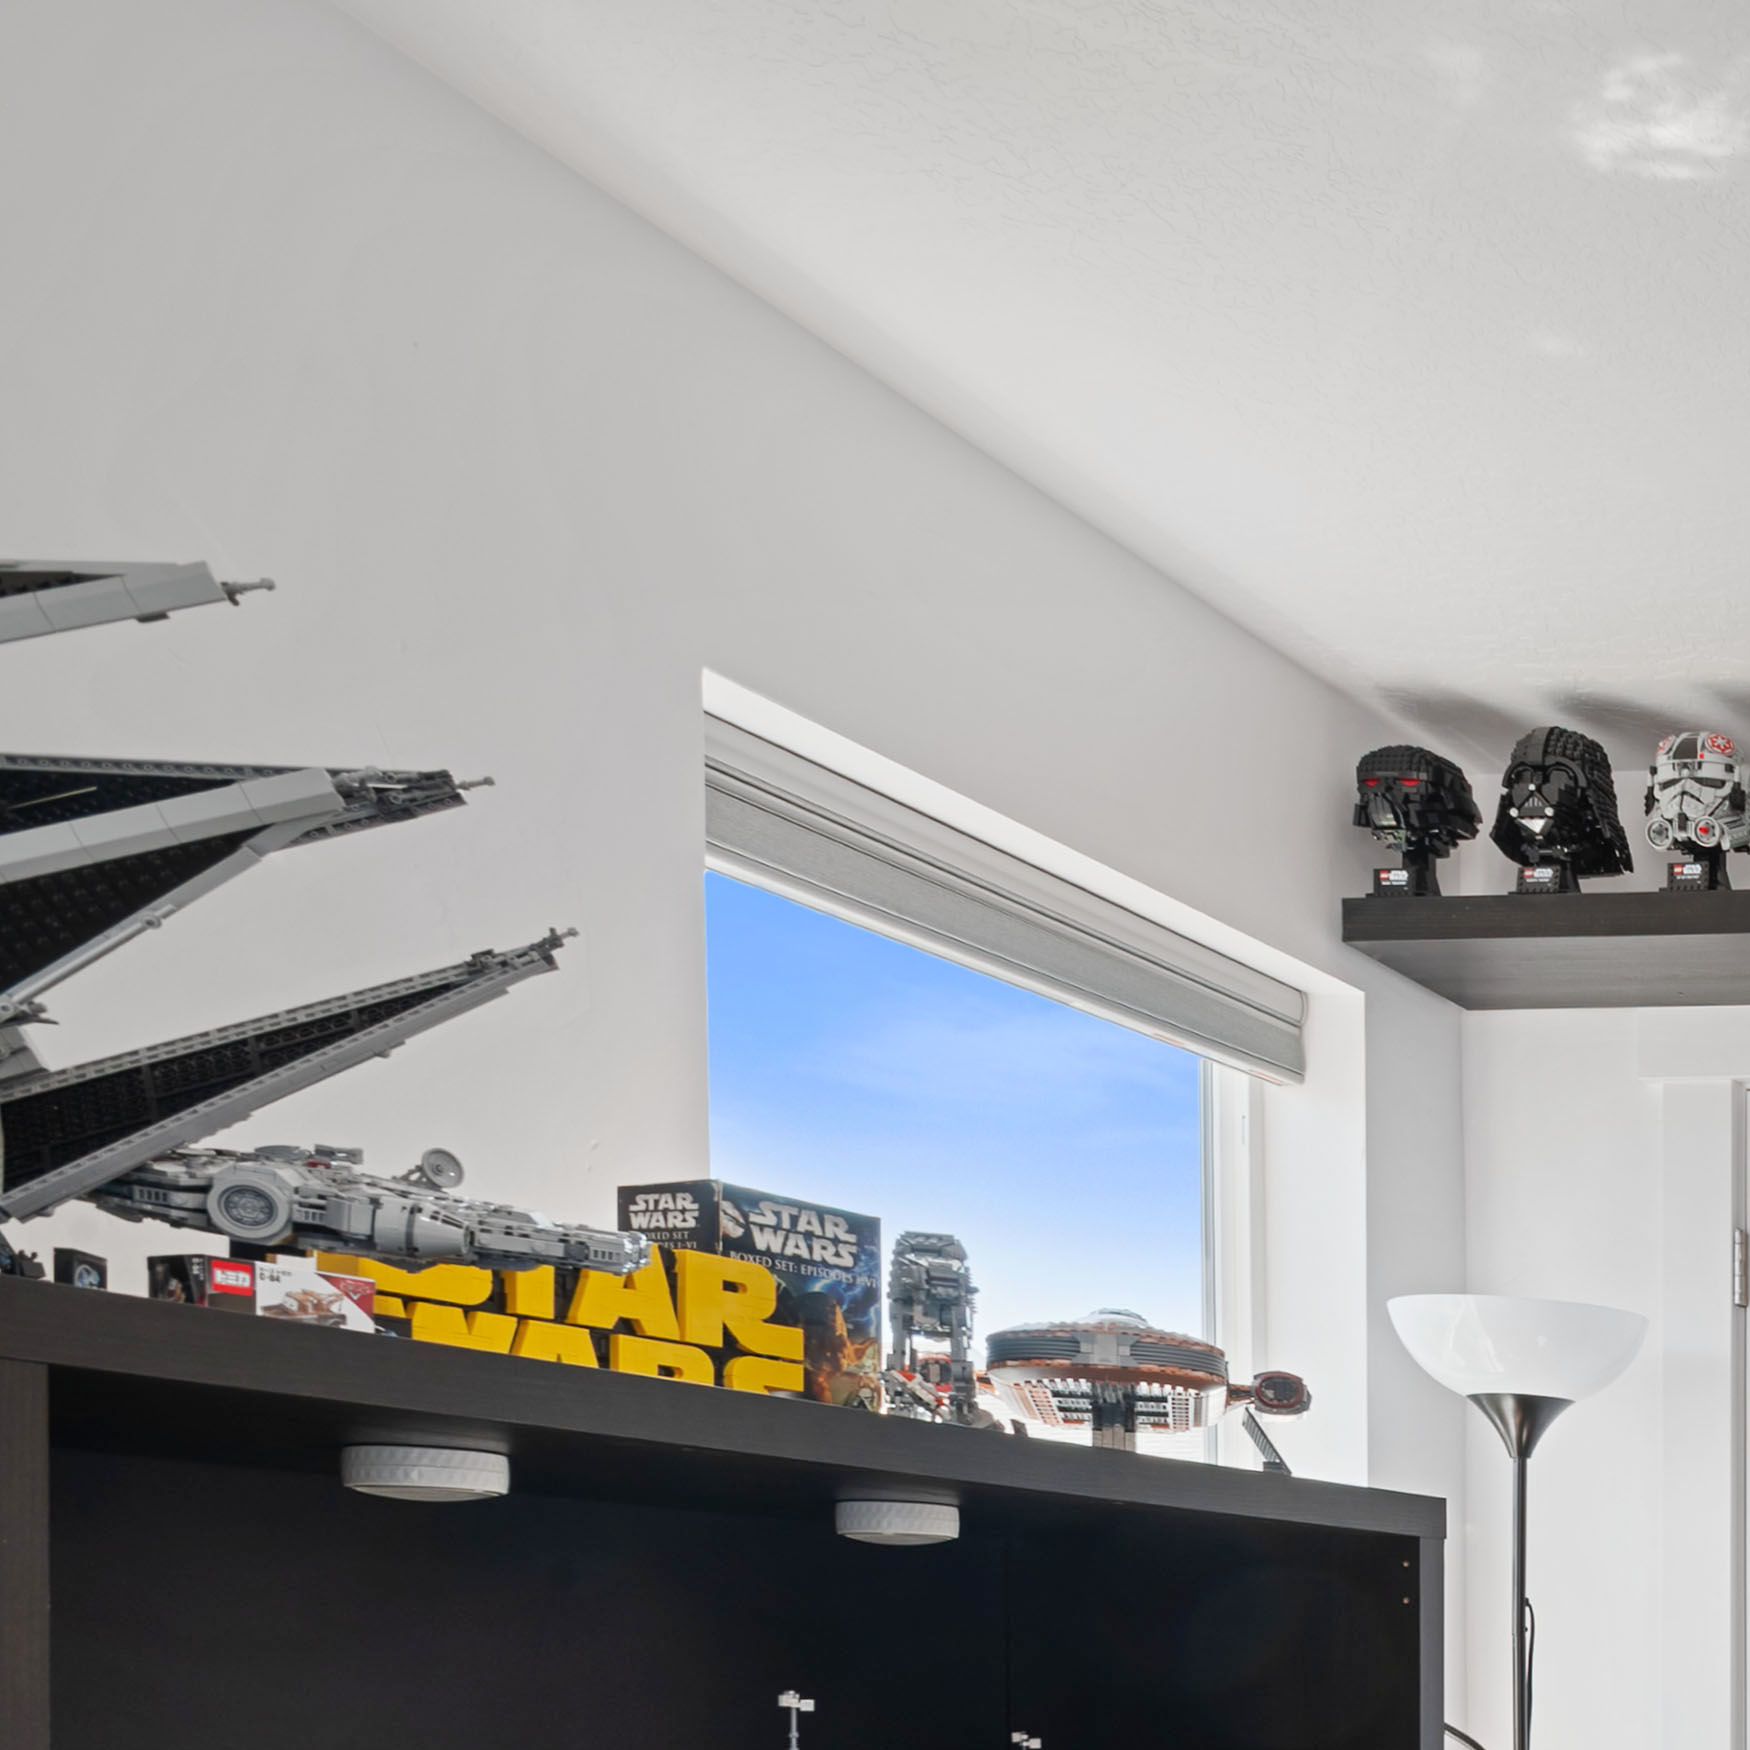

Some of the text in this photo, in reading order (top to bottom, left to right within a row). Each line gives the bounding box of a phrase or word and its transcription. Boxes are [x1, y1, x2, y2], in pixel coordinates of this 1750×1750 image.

[628, 1192, 699, 1211] STAR
[628, 1210, 700, 1229] WARS
[748, 1200, 857, 1244] STAR
[749, 1223, 857, 1268] WARS
[801, 1264, 853, 1284] EPISODES
